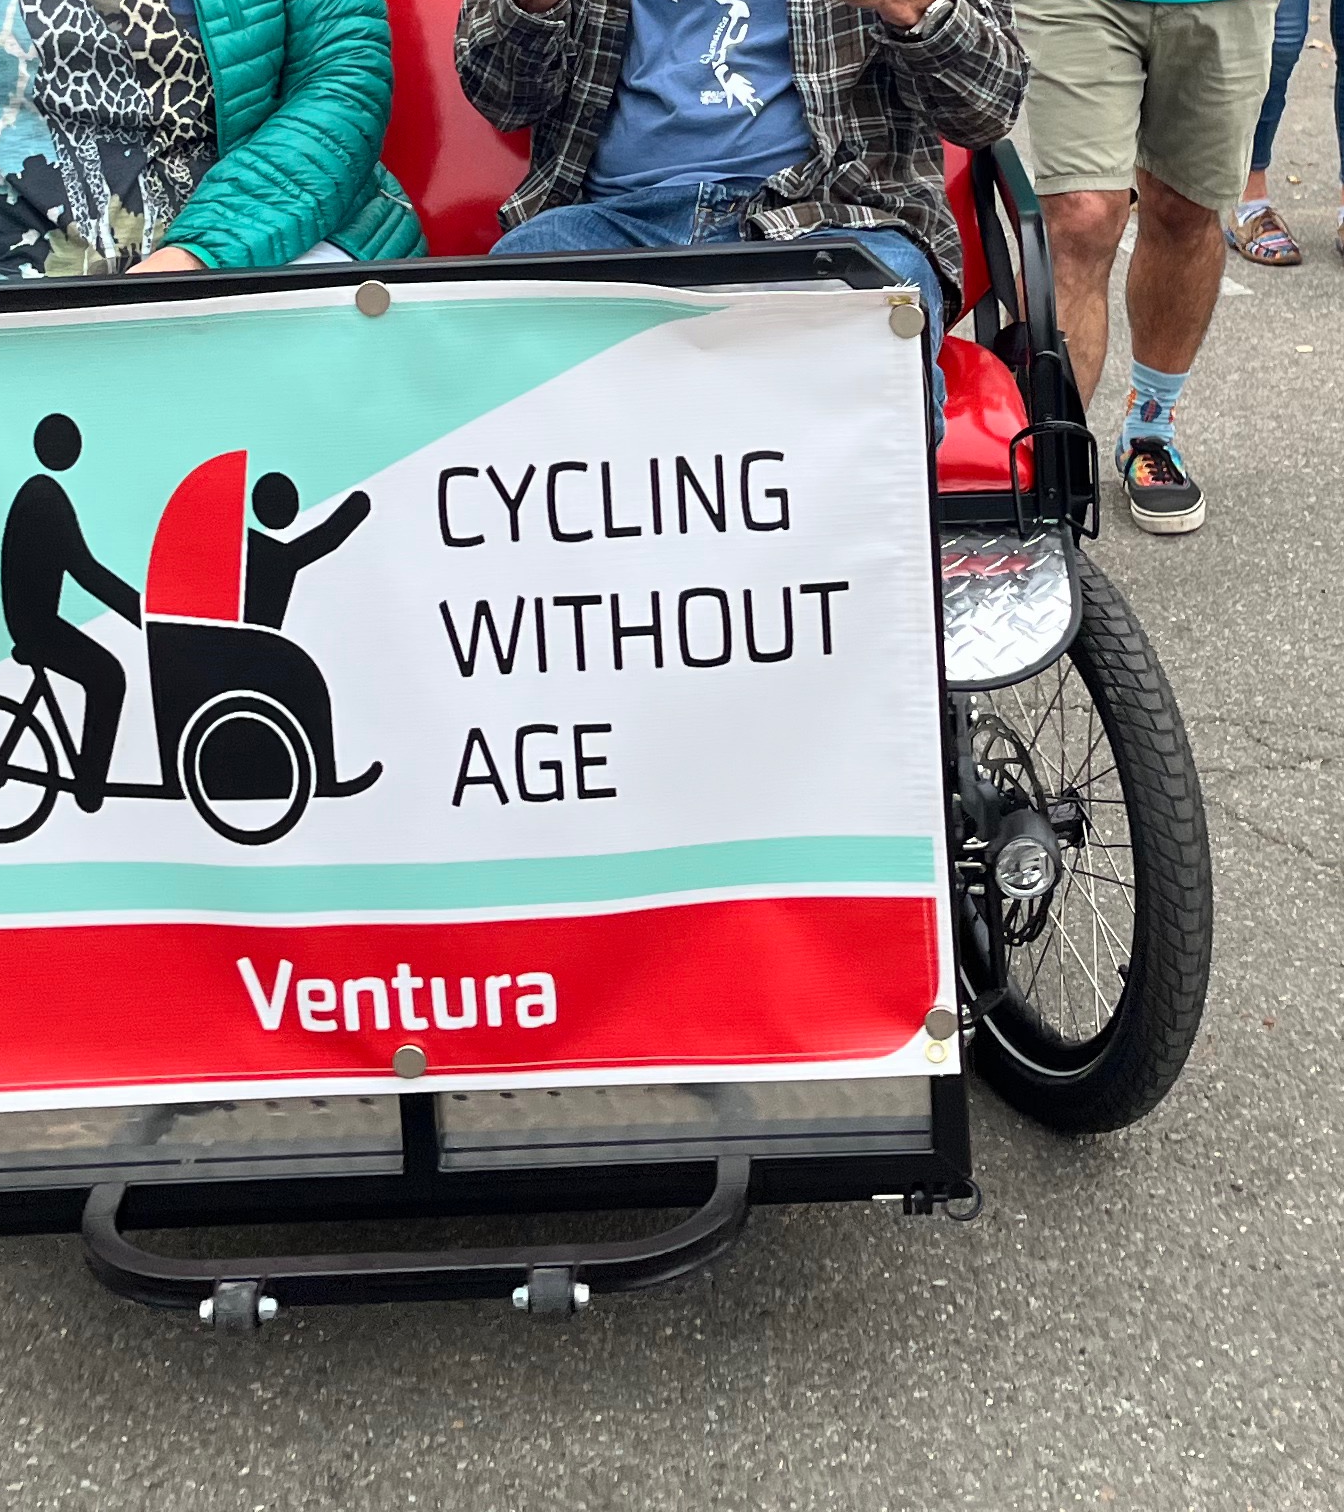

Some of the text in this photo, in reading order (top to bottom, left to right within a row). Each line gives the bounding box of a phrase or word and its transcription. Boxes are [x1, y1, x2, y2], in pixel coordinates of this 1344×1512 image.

[437, 450, 790, 548] CYCLING
[439, 581, 850, 677] WITHOUT
[452, 723, 617, 807] AGE
[236, 956, 557, 1032] Ventura
